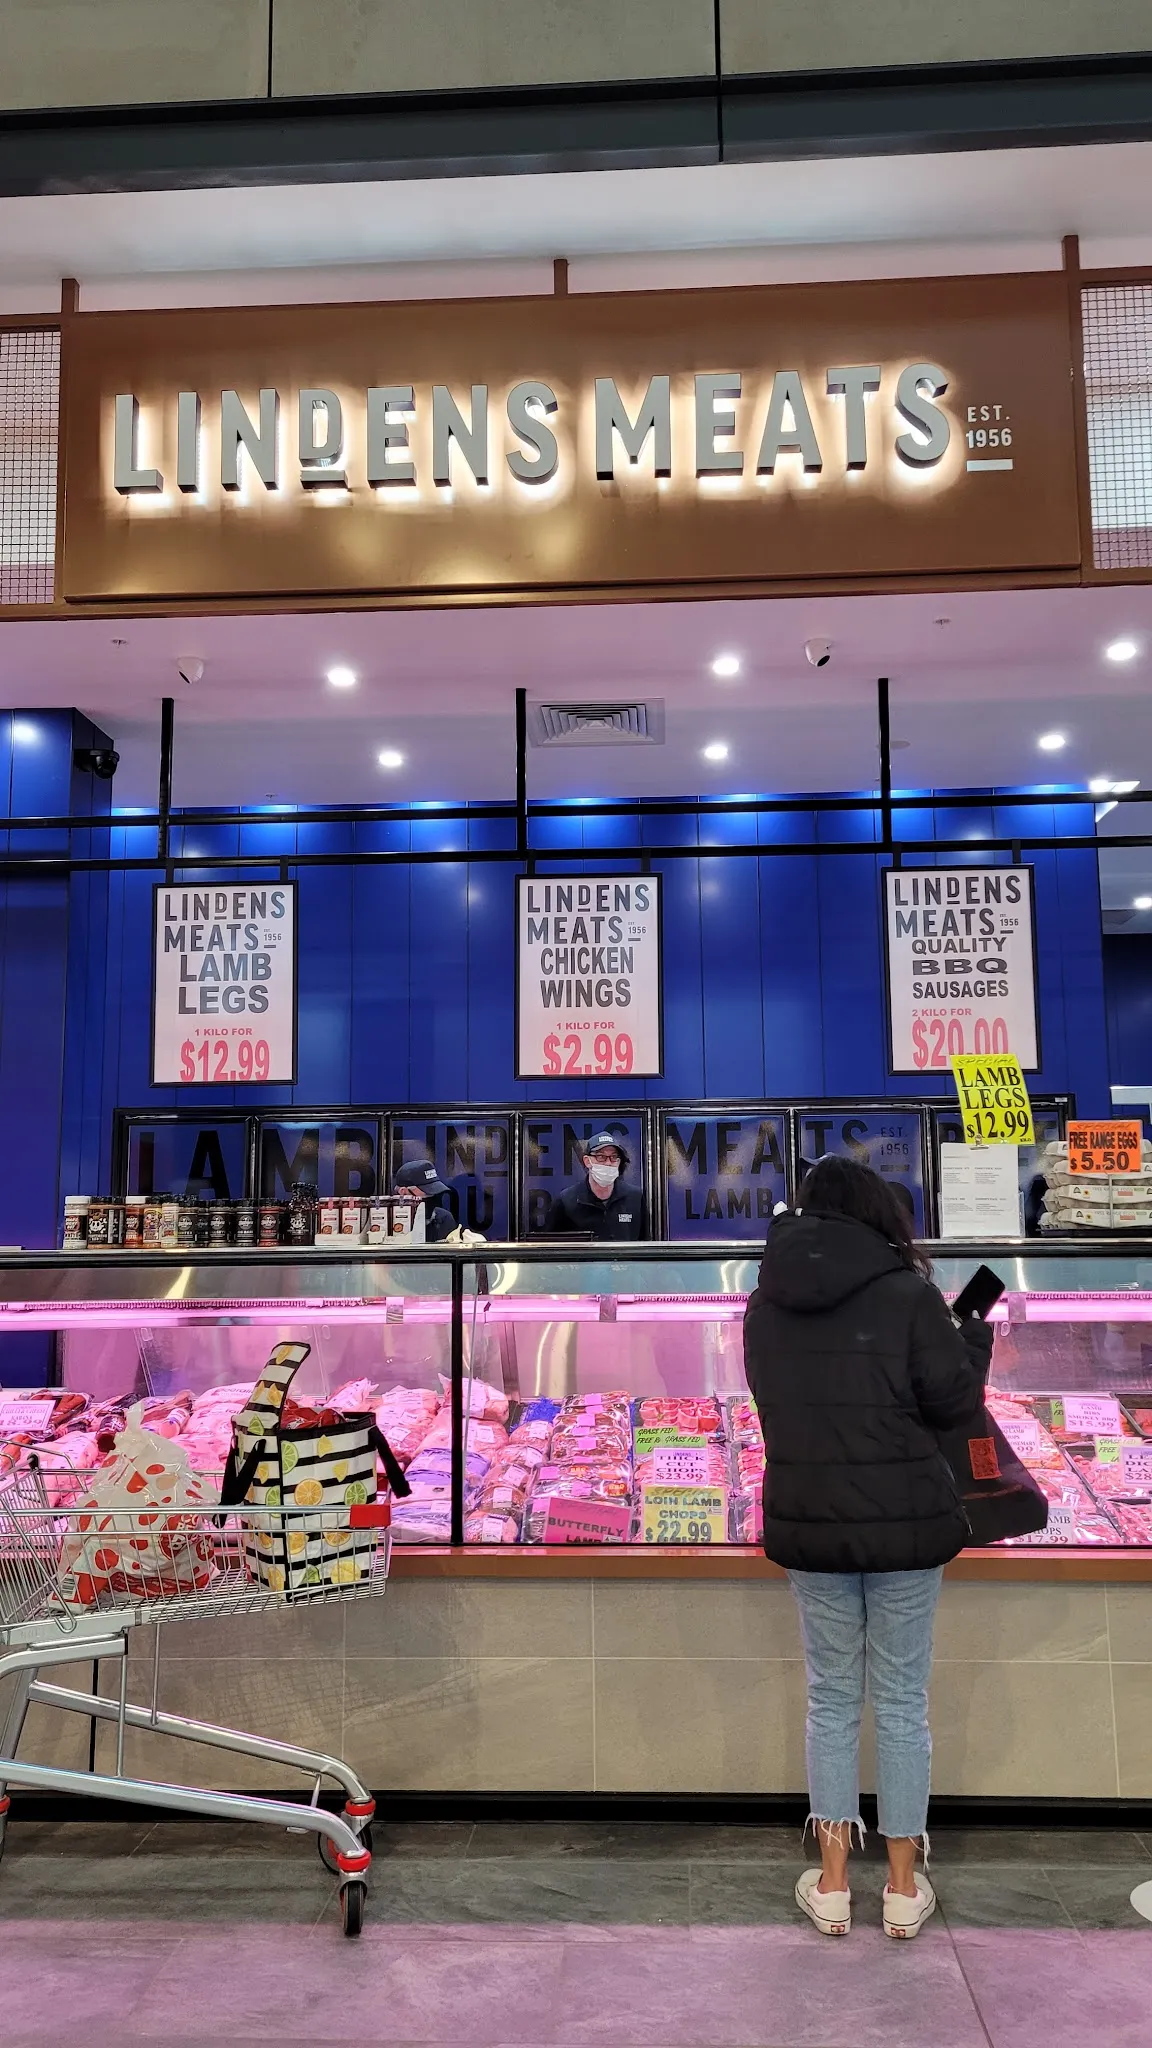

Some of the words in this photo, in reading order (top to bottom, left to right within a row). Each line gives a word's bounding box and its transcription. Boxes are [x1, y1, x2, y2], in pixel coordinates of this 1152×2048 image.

[965, 405, 1010, 423] EST.
[115, 381, 558, 494] LINDENS
[595, 362, 951, 485] MEATS
[966, 429, 1012, 450] 1956
[527, 884, 650, 913] LINDENS
[894, 875, 1021, 906] LINDENS
[164, 891, 285, 921] LINDENS
[527, 915, 623, 944] MEATS
[628, 926, 647, 934] 1956
[895, 908, 995, 938] MEATS
[1000, 918, 1019, 927] 1956
[164, 924, 259, 952] MEATS
[264, 933, 282, 941] 1956
[912, 937, 1007, 955] QUALITY
[180, 953, 272, 982] LAMB
[540, 946, 634, 975] CHICKEN
[912, 957, 1009, 976] BBQ
[540, 978, 631, 1008] WINGS
[912, 979, 1009, 999] SAUSAGES
[178, 985, 269, 1015] LEGS
[912, 1009, 919, 1017] 2
[921, 1008, 947, 1016] KILO
[950, 1007, 972, 1016] FOR
[203, 1028, 228, 1036] KILO
[566, 1022, 591, 1030] KILO
[594, 1021, 615, 1029] FOR
[912, 1016, 1009, 1069] $2000
[179, 1038, 270, 1082] $12.99
[542, 1032, 634, 1075] $2.99
[957, 1066, 1021, 1087] LAMB
[962, 1087, 1026, 1109] LEGS
[966, 1110, 1029, 1138] $12.99
[667, 1119, 870, 1176] MEATS
[880, 1144, 910, 1156] 1956
[1069, 1131, 1088, 1149] FREE
[1090, 1131, 1116, 1149] RANGE
[1117, 1131, 1138, 1149] EGGS
[638, 1427, 659, 1436] GRASS
[1068, 1420, 1114, 1428] $15.99
[664, 1435, 687, 1443] GRASS
[656, 1472, 704, 1480] $23.99
[645, 1496, 679, 1505] LOIN
[682, 1497, 722, 1507] LAMB
[659, 1510, 707, 1519] CHOPS
[1048, 1515, 1071, 1524] AMB
[548, 1517, 624, 1537] BUTTERFLY
[1033, 1527, 1062, 1535] HOPS
